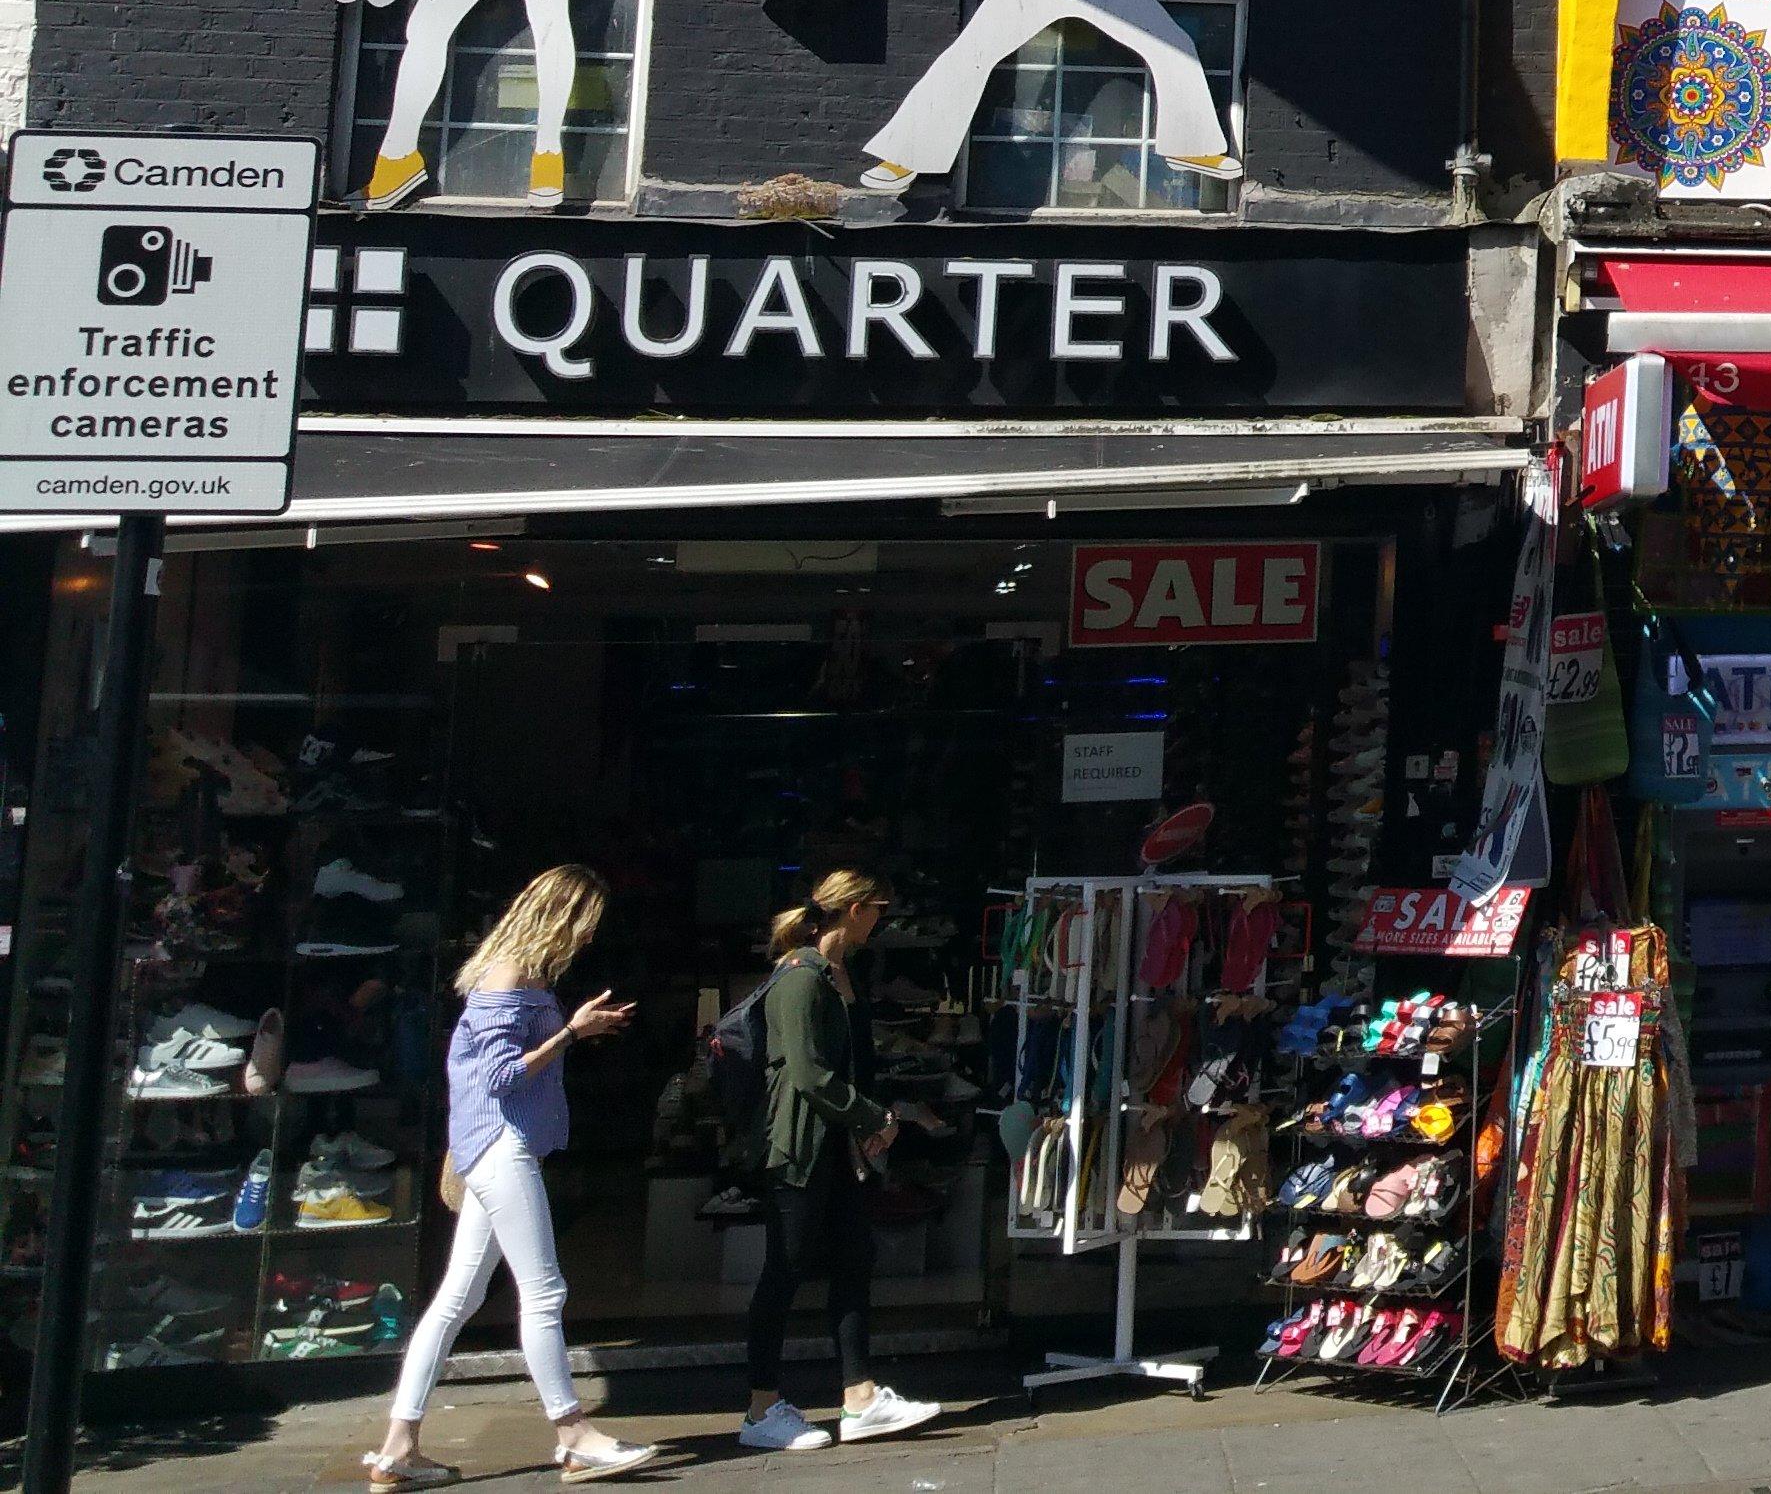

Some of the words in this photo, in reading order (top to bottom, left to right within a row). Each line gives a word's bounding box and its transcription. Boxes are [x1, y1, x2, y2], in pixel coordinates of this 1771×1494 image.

[113, 157, 285, 191] Camden
[492, 250, 1241, 381] QUARTER
[79, 325, 216, 360] Traffic
[7, 368, 280, 400] enforcement
[50, 411, 230, 440] cameras
[1587, 398, 1619, 475] ATM
[36, 474, 232, 500] camden.gov.uk
[1079, 555, 1309, 632] SALE
[1553, 618, 1603, 647] sale
[1547, 657, 1601, 700] £2.99
[1074, 745, 1114, 758] STAFF
[1073, 766, 1142, 780] REQUIRED
[1377, 931, 1407, 944] MORE
[1409, 932, 1439, 944] SIZES
[1441, 933, 1497, 946] AVAILABLE
[1594, 994, 1637, 1016] sale
[1582, 1020, 1638, 1062] £5.99
